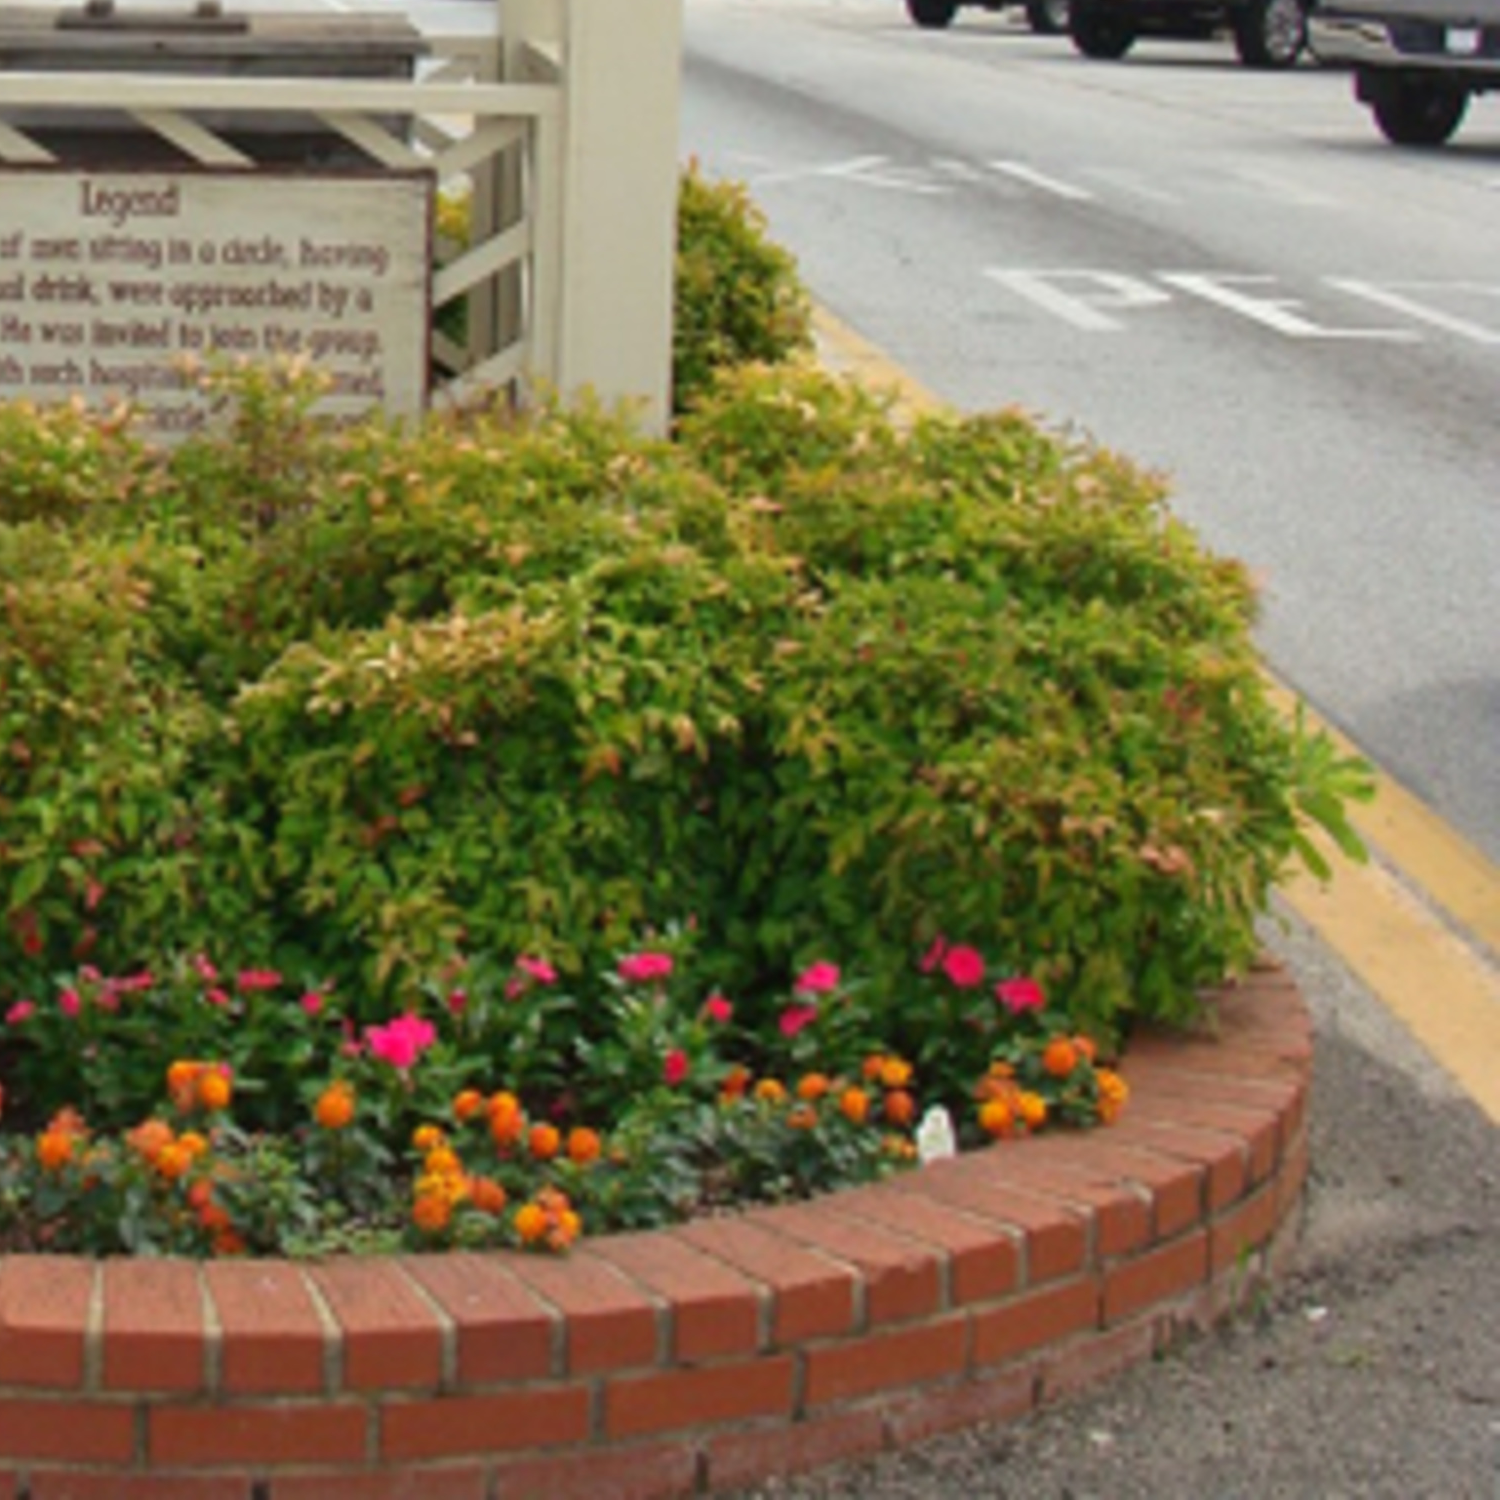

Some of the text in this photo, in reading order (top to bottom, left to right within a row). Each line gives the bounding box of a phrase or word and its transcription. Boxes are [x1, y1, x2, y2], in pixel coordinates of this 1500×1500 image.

[79, 178, 180, 228] Legend
[0, 232, 23, 259] of
[90, 235, 162, 269] sitting
[168, 237, 192, 264] in
[199, 241, 216, 264] a
[300, 238, 389, 277] having
[108, 279, 163, 306] were
[168, 279, 313, 315] approached
[318, 281, 349, 318] by
[355, 287, 373, 313] a
[0, 315, 32, 344] He
[40, 322, 84, 345] was
[90, 317, 170, 348] invited
[180, 323, 203, 348] to
[209, 324, 258, 350] join
[264, 324, 301, 353] the
[30, 357, 83, 385] such
